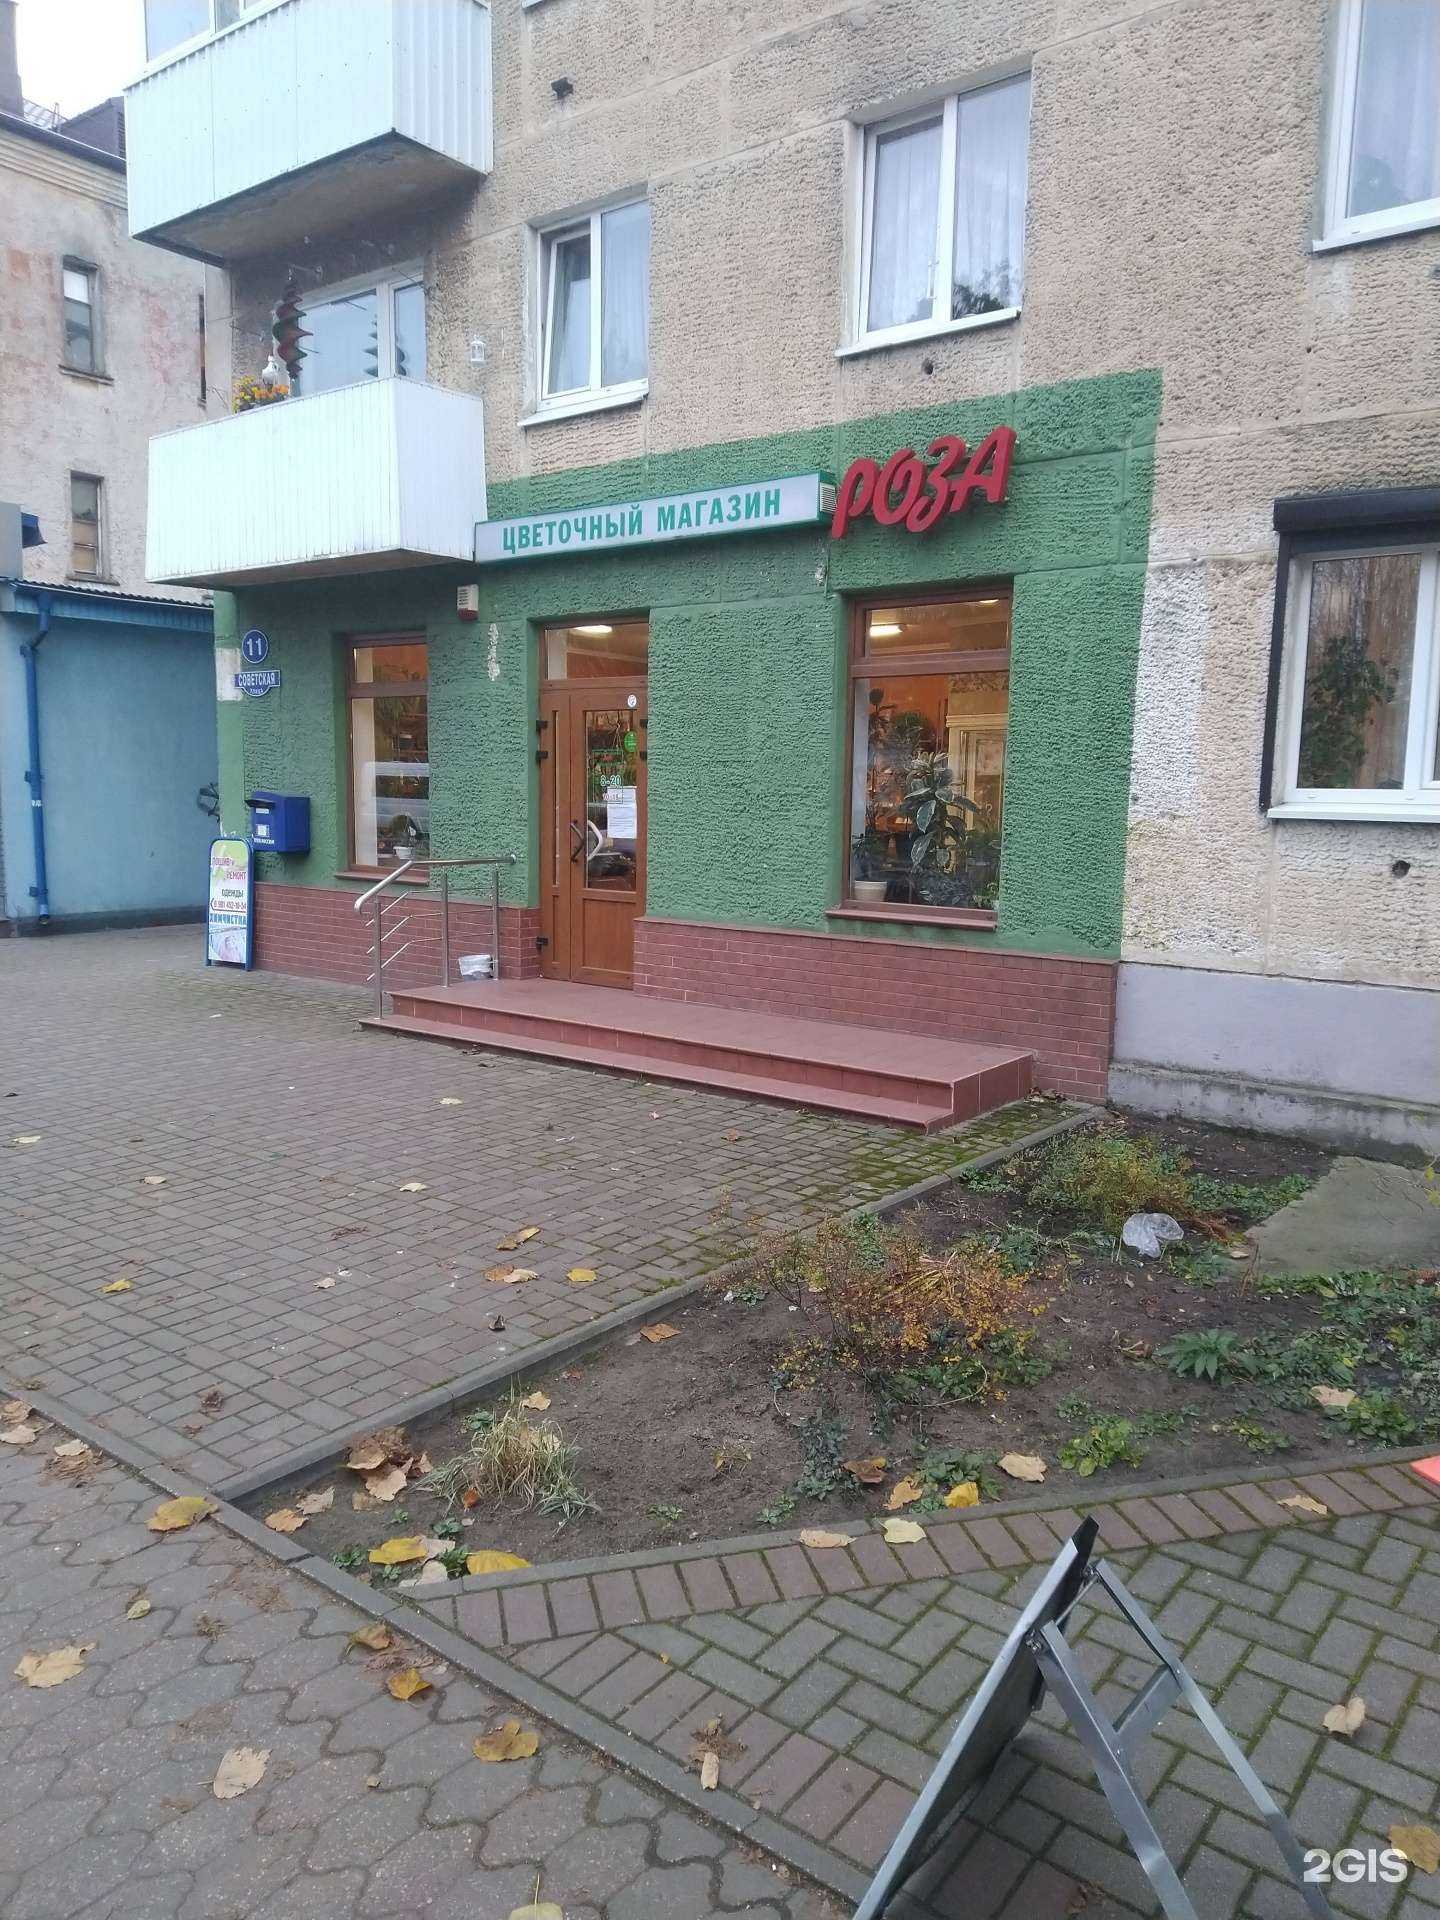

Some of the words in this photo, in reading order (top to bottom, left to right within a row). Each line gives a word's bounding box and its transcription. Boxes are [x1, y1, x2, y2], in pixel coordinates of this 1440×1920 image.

[831, 425, 1017, 539] РОЗА
[503, 504, 643, 554] ЦВЕТОЧНЫЙ
[657, 488, 781, 532] МАГАЗИН
[247, 638, 261, 656] 11
[239, 673, 275, 686] СОВЕТСКАЯ
[210, 913, 246, 925] ХИМЧИСТКА
